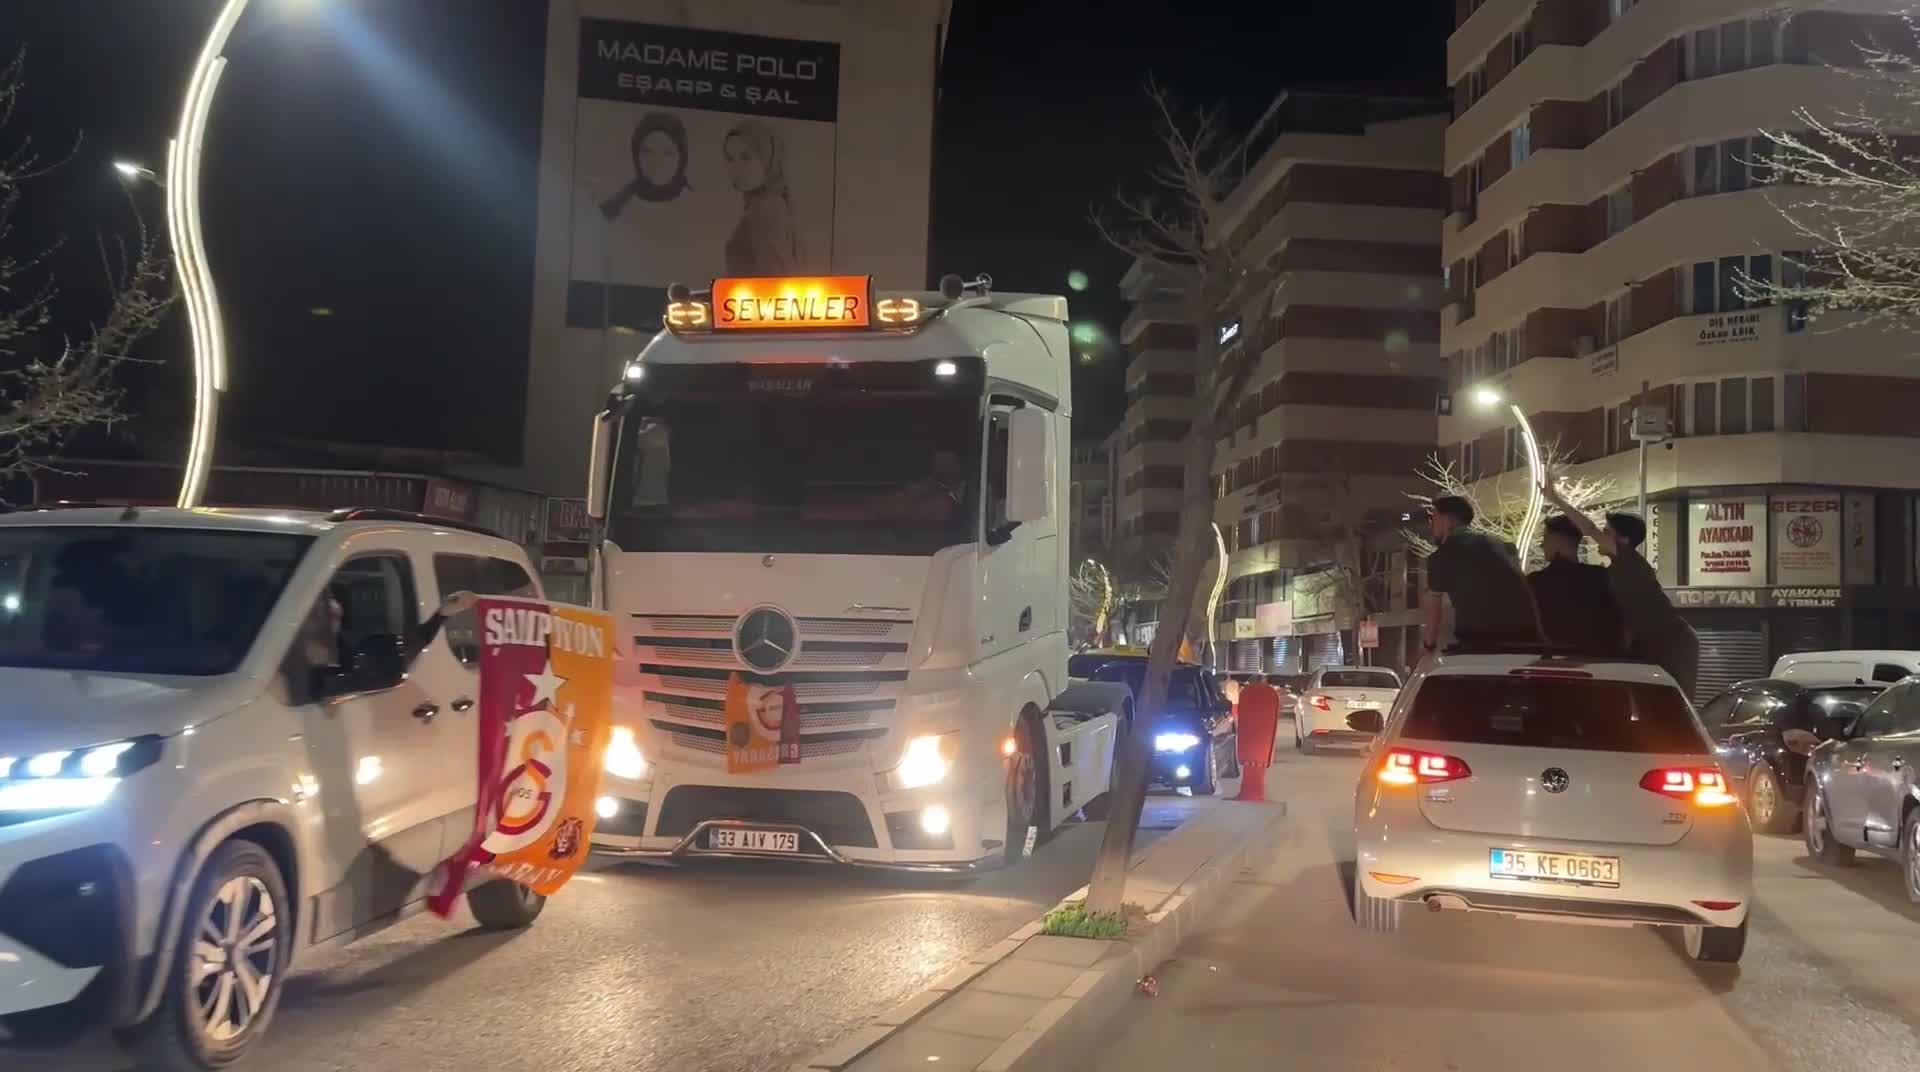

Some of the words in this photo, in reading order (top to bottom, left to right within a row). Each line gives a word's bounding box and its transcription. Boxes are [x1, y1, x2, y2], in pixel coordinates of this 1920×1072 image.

[597, 39, 729, 71] MADAME
[737, 53, 817, 80] POLO
[617, 72, 713, 94] EŞARP
[719, 84, 737, 98] &
[745, 86, 799, 104] ŞAL
[722, 296, 859, 322] SEVENLER
[1705, 502, 1745, 521] ALTIN
[1772, 501, 1840, 513] GEZER
[1675, 590, 1756, 605] TOPTAN
[720, 832, 736, 846] 33
[773, 833, 795, 849] 179
[1504, 853, 1526, 872] 35
[1537, 855, 1560, 875] KE
[1567, 858, 1613, 880] 0663
